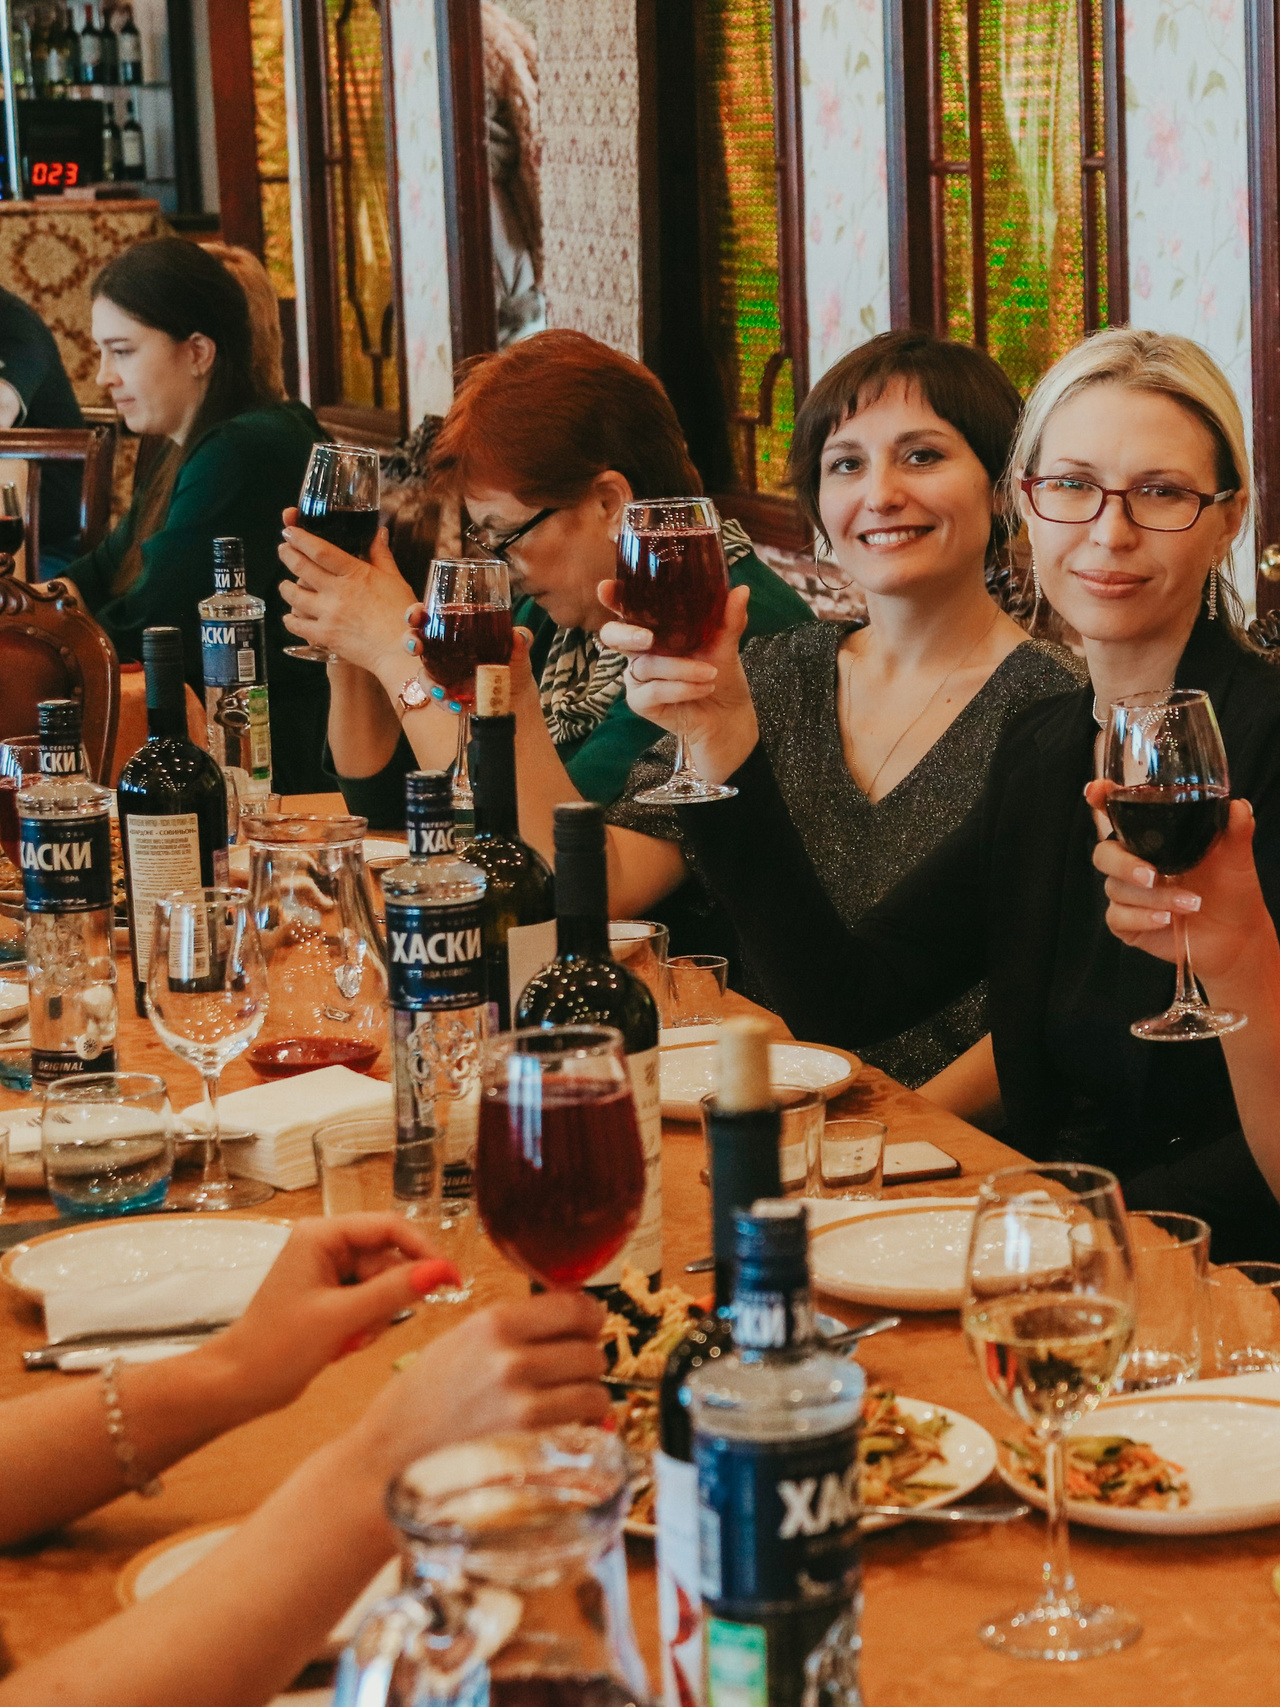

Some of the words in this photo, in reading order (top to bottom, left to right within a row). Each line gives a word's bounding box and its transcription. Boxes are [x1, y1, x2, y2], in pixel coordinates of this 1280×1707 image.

[32, 162, 79, 186] 023
[392, 927, 481, 965] ХАСКИ
[38, 1061, 84, 1071] ORIGINAL
